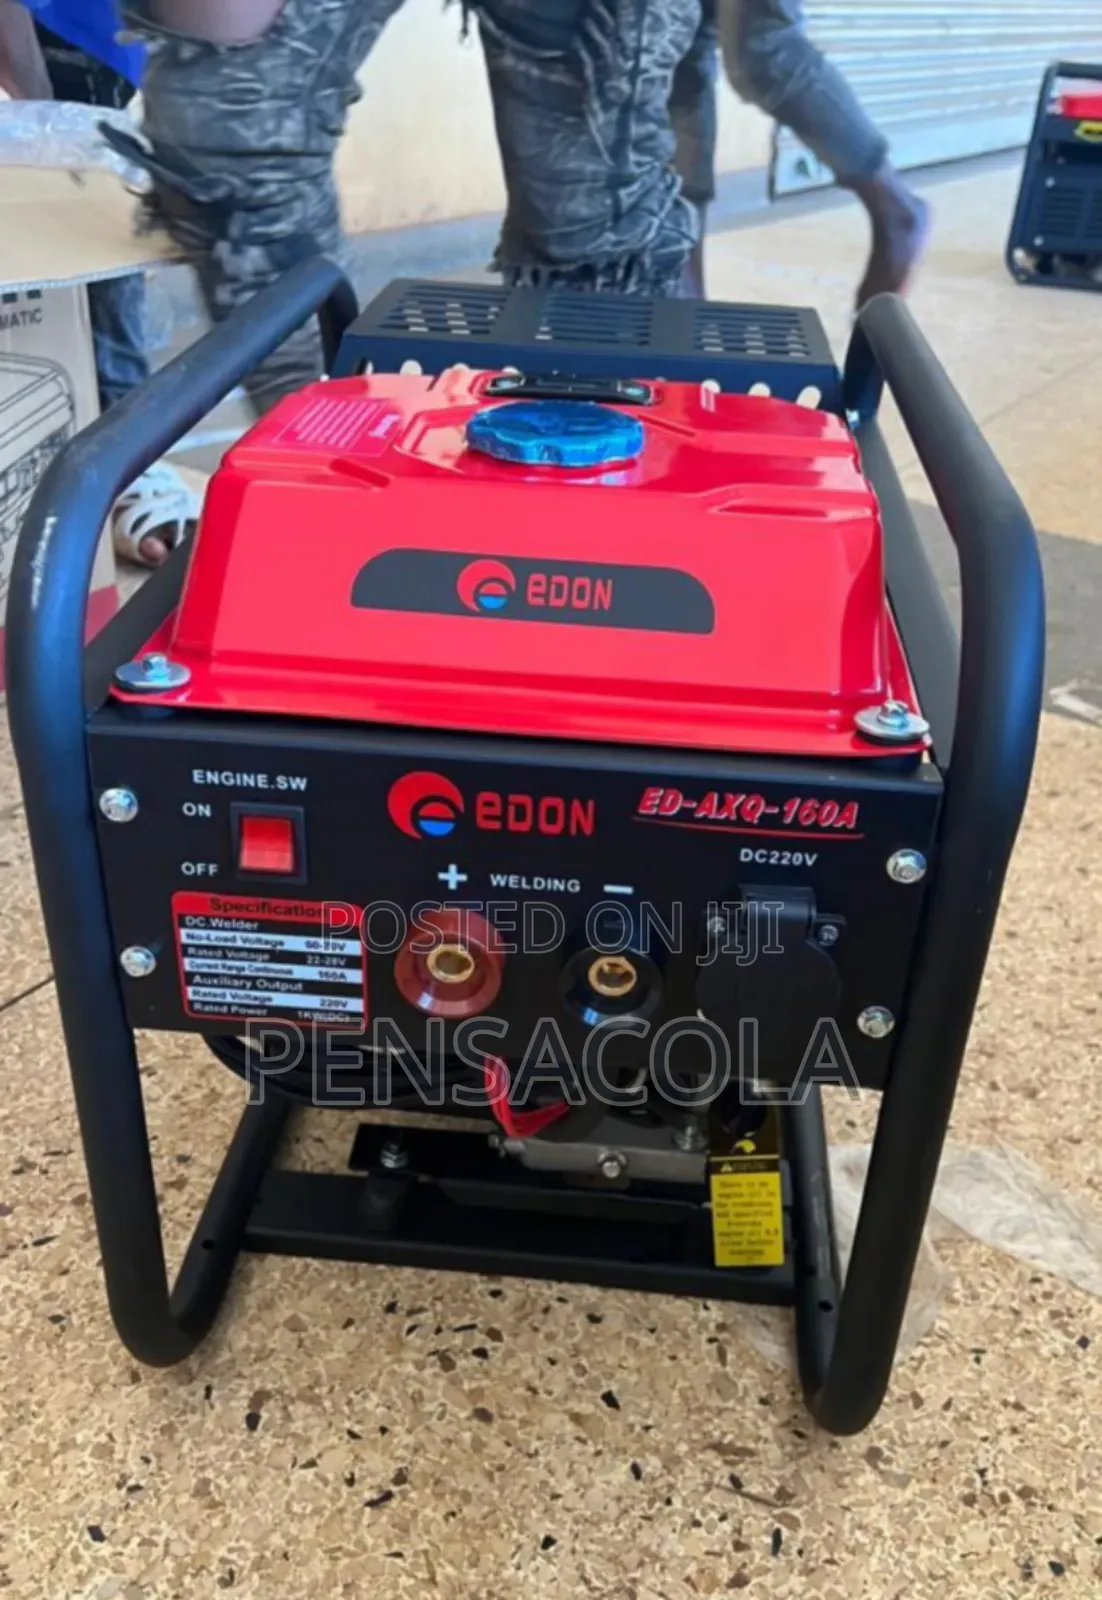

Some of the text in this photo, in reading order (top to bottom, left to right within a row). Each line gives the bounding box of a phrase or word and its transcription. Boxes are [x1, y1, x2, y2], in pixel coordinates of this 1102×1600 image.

[193, 769, 307, 791] ENGINE.SW
[182, 802, 211, 817] ON
[638, 787, 860, 829] ED-AXQ-160A
[740, 848, 818, 867] DC220V
[181, 862, 219, 877] OFF
[490, 874, 580, 892] WELDING
[186, 932, 237, 944] No-Load
[241, 936, 285, 948] Voltage
[187, 947, 222, 958] Rated
[226, 948, 270, 961] Voltage
[318, 970, 347, 980] 160A
[192, 975, 303, 992] Auxiliary Output
[192, 989, 348, 1008] Rated Voltage 220V
[193, 1004, 228, 1014] Rated
[231, 1005, 268, 1016] Power
